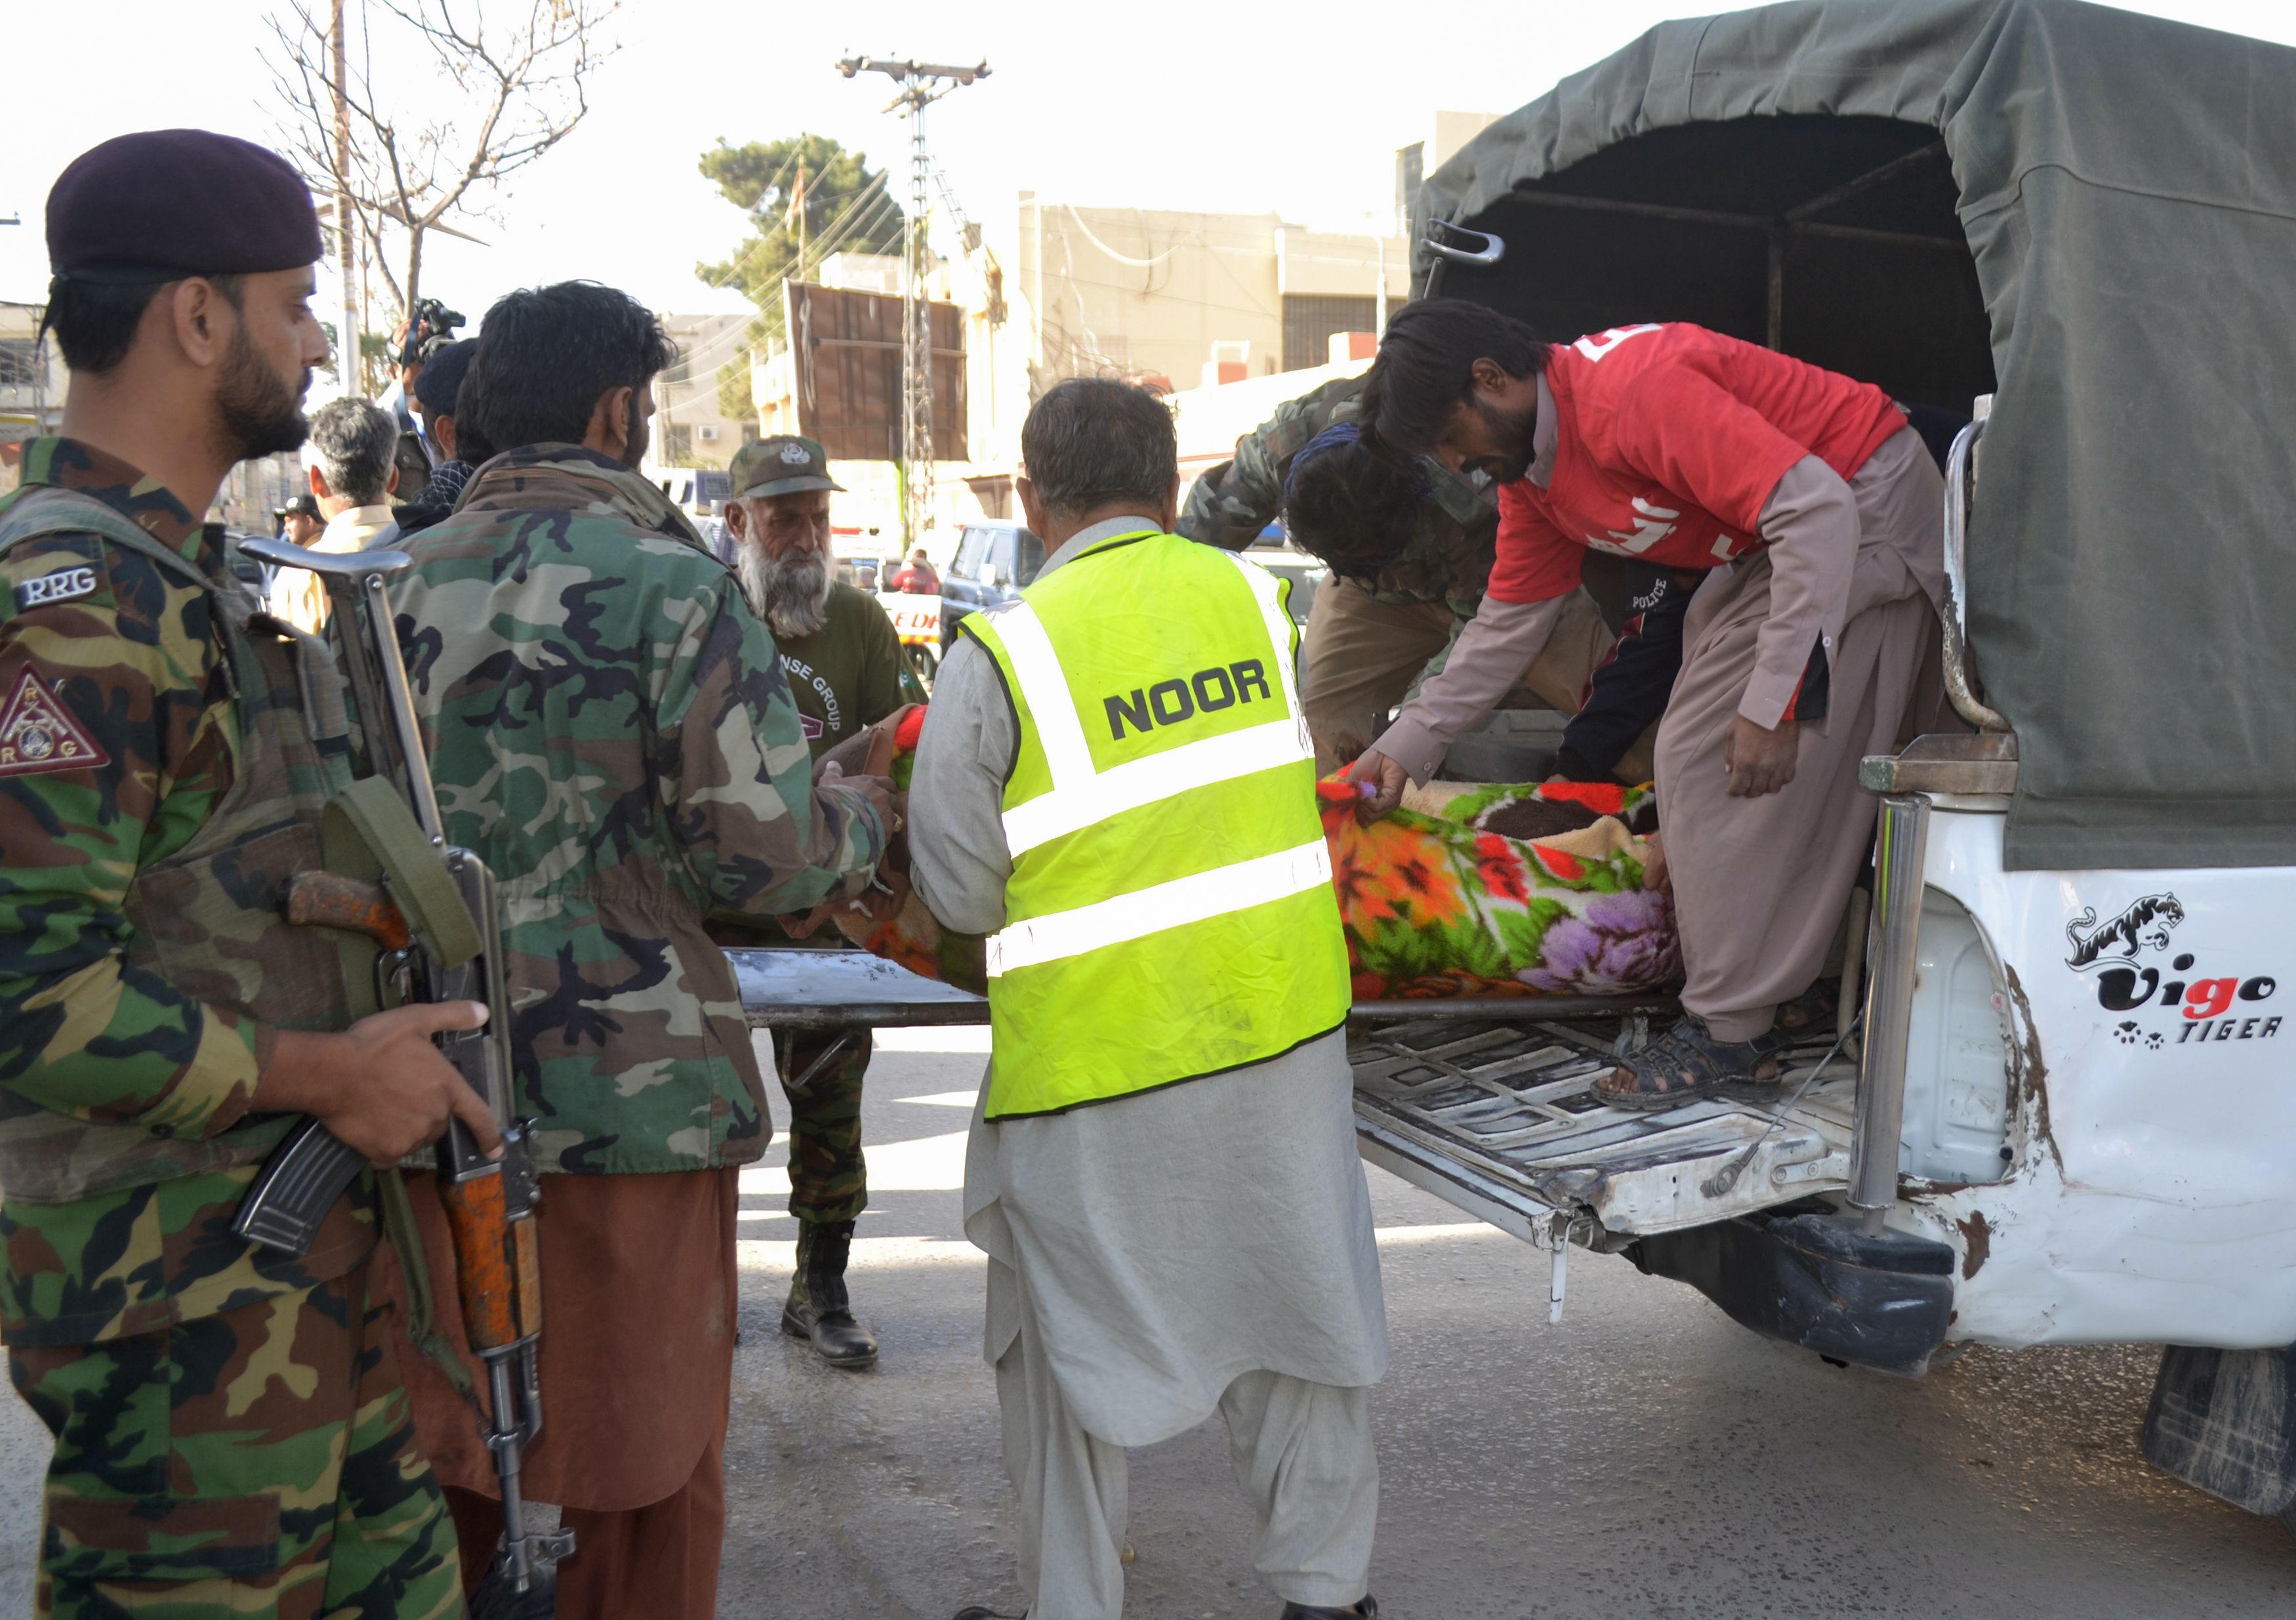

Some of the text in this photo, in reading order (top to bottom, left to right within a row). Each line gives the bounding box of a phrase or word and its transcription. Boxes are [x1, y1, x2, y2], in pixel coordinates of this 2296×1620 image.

[20, 567, 97, 605] RRG
[1632, 578, 1667, 608] POLICE
[25, 687, 37, 701] R
[813, 677, 840, 731] GROUP
[1103, 658, 1271, 741] NOOR
[1, 740, 77, 764] R G
[2175, 1016, 2284, 1043] TIGER
